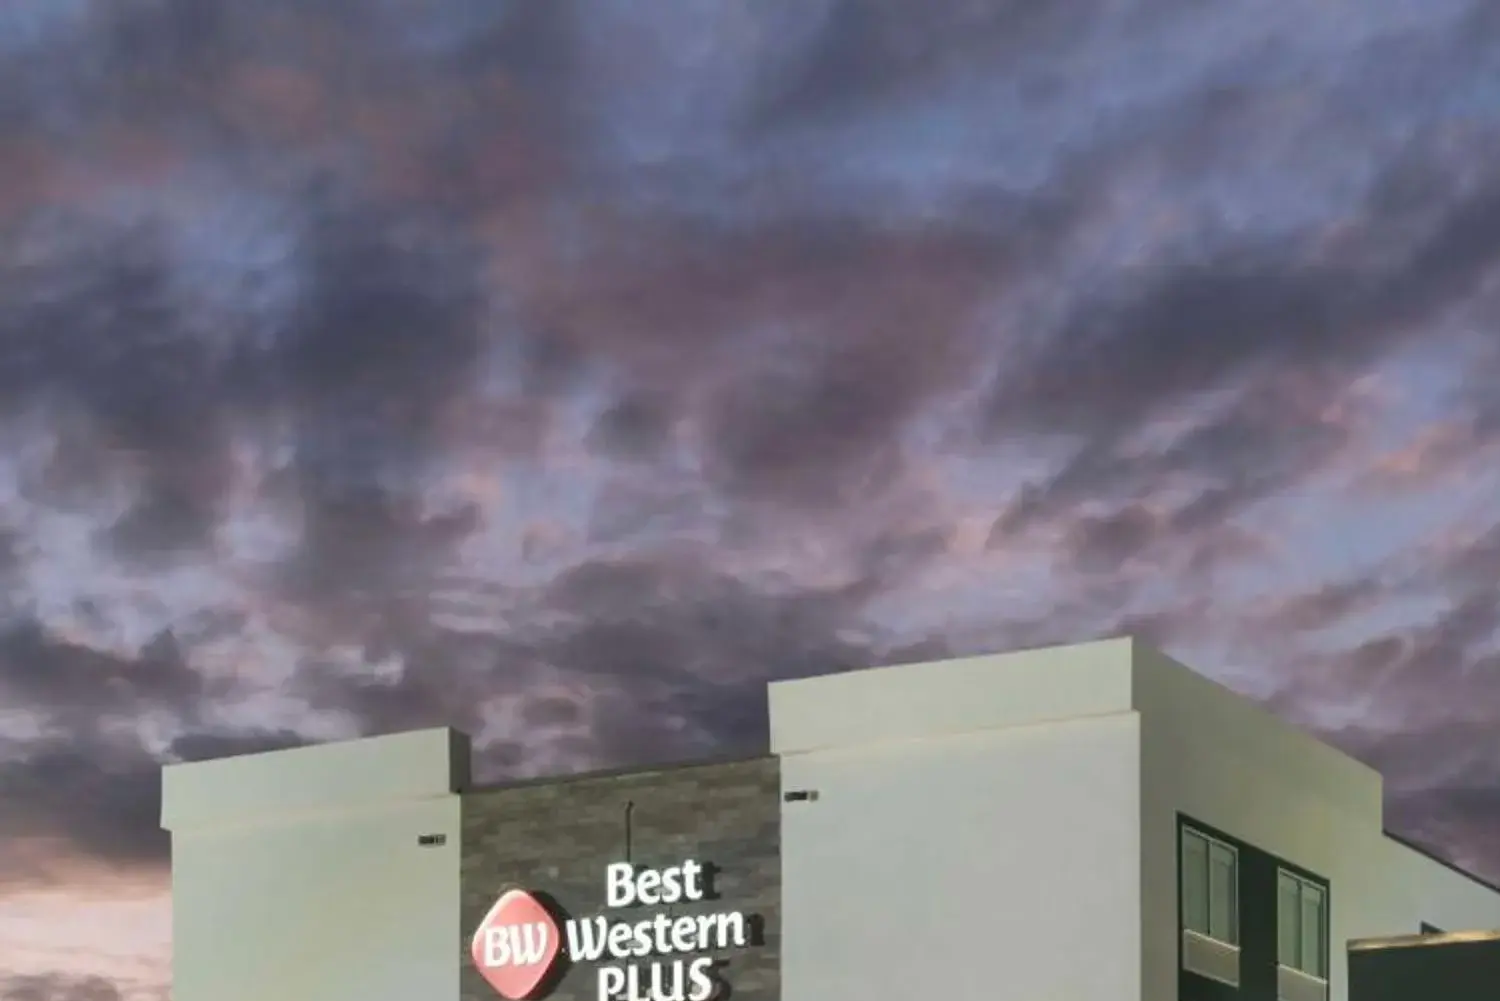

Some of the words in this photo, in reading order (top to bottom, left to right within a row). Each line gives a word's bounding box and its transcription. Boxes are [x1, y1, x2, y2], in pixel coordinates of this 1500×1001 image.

[606, 859, 702, 907] Best
[484, 921, 548, 967] BW
[565, 910, 745, 962] Western
